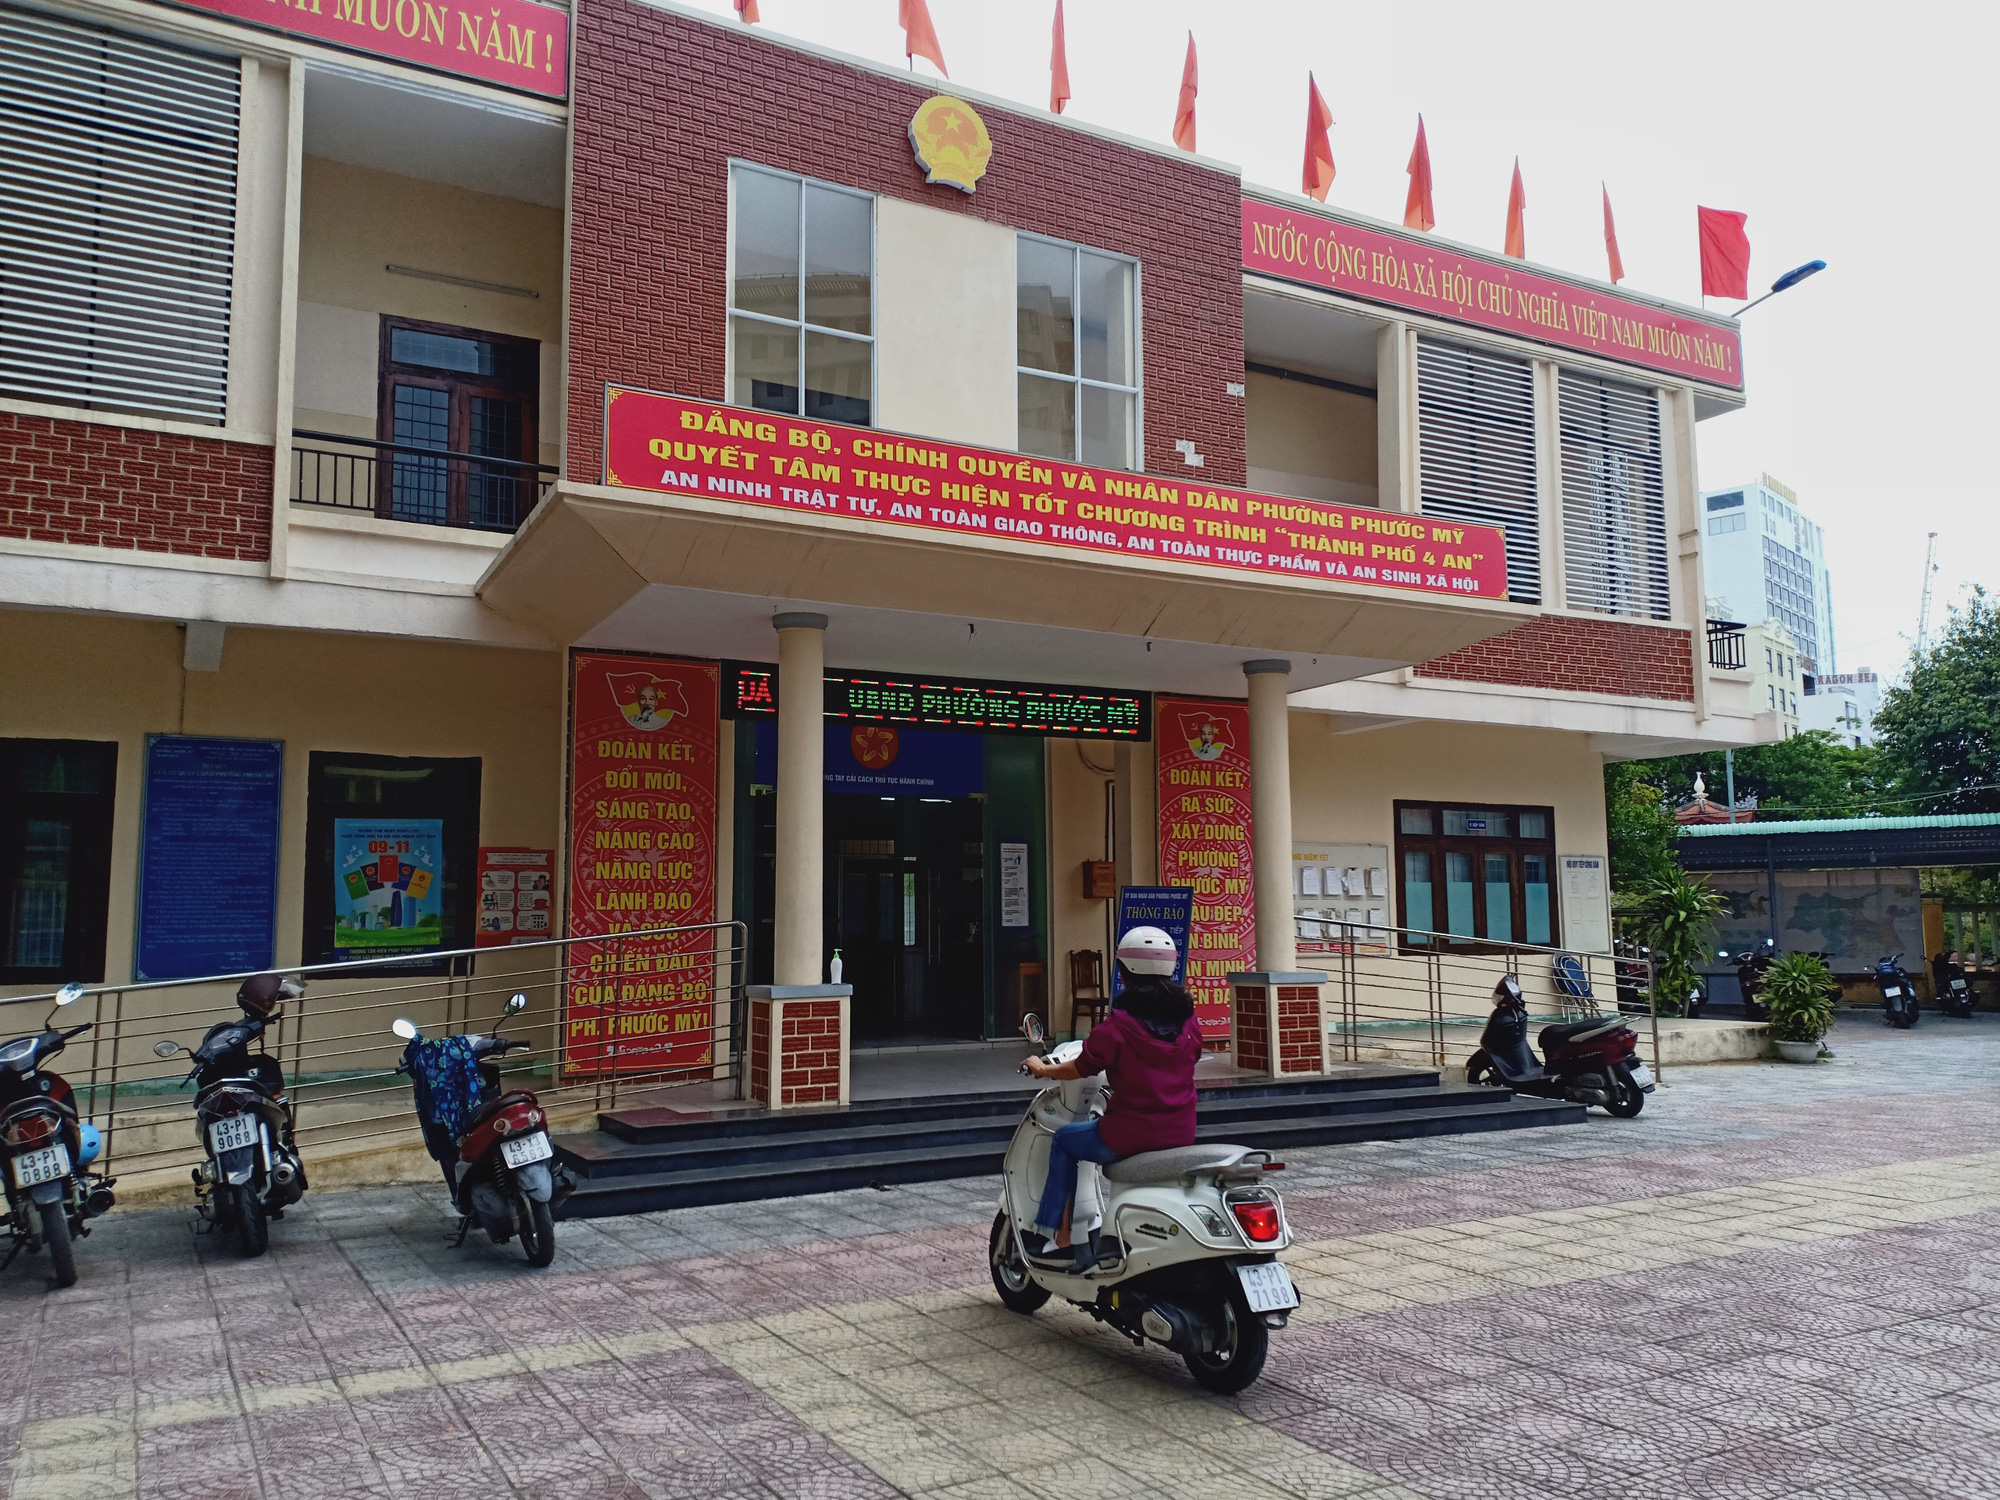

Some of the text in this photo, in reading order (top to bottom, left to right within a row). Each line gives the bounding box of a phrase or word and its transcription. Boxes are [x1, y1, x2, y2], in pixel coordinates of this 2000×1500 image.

[457, 7, 536, 68] NĂM
[1252, 219, 1308, 266] NƯỚC
[1314, 230, 1367, 283] CỘNG
[1371, 246, 1411, 291] HÒA
[1413, 257, 1437, 298] XÃ
[1441, 264, 1473, 313] HỘI
[1478, 273, 1513, 317] CHỦ
[1517, 291, 1570, 332] NGHĨA
[1571, 301, 1608, 346] VIỆT
[1611, 315, 1644, 351] NAM
[1647, 322, 1691, 362] MUÔN
[1693, 333, 1725, 371] NĂM
[679, 410, 1465, 545] ĐẢNG BỘ, CHÍNH QUYỀN VÀ NHÂN DÂN PHƯỜNG PHƯỚC MỸ
[648, 438, 1484, 571] QUYẾT TÂM THỰC HIỆN TỐT CHƯƠNG TRÌNH “THÀNH PHỐ 4 AN”
[660, 470, 1479, 593] AN NINH TRẬT TỰ, AN TOÀN GIAO THÔNG, AN TOÀN THỰC PHẨM VÀ AN SINH XÃ HỘI
[1818, 674, 1853, 684] RAGON
[849, 689, 914, 711] UBND
[597, 738, 695, 763] ĐOÀN KẾT,
[605, 765, 687, 792] ĐỔI MỚI,
[1170, 766, 1245, 789] ĐOÀN KẾT,
[595, 798, 696, 823] SÁNG TẠO,
[1181, 794, 1235, 813] RA SỨC
[595, 828, 695, 850] NÂNG CAO
[1172, 820, 1245, 844] XÂY DỰNG
[368, 840, 409, 853] 09-11
[1178, 847, 1239, 867] PHƯỜNG
[595, 859, 693, 883] NĂNG LỰC
[1171, 874, 1247, 895] PHƯỚC MỸ
[595, 889, 692, 913] LÃNH ĐẠO
[1126, 902, 1185, 920] THÔNG BÁO
[1214, 905, 1245, 925] ĐẸP,
[640, 918, 678, 940] SỨC
[1203, 930, 1243, 950] BÌNH,
[590, 946, 696, 973] CHẾN ĐẤU
[1206, 960, 1245, 976] MINH
[575, 978, 707, 1005] CỦA ĐẢNG BỘ
[571, 1009, 708, 1037] PH. PHƯỚC MỸ!
[216, 1119, 248, 1136] 43-P1
[218, 1130, 252, 1150] 9068
[508, 1135, 541, 1153] 43-X3
[21, 1149, 57, 1169] 43-P1
[512, 1147, 545, 1165] 6563
[23, 1163, 62, 1184] 0888
[1246, 1267, 1282, 1286] 43-P1
[1253, 1287, 1291, 1308] 7198
